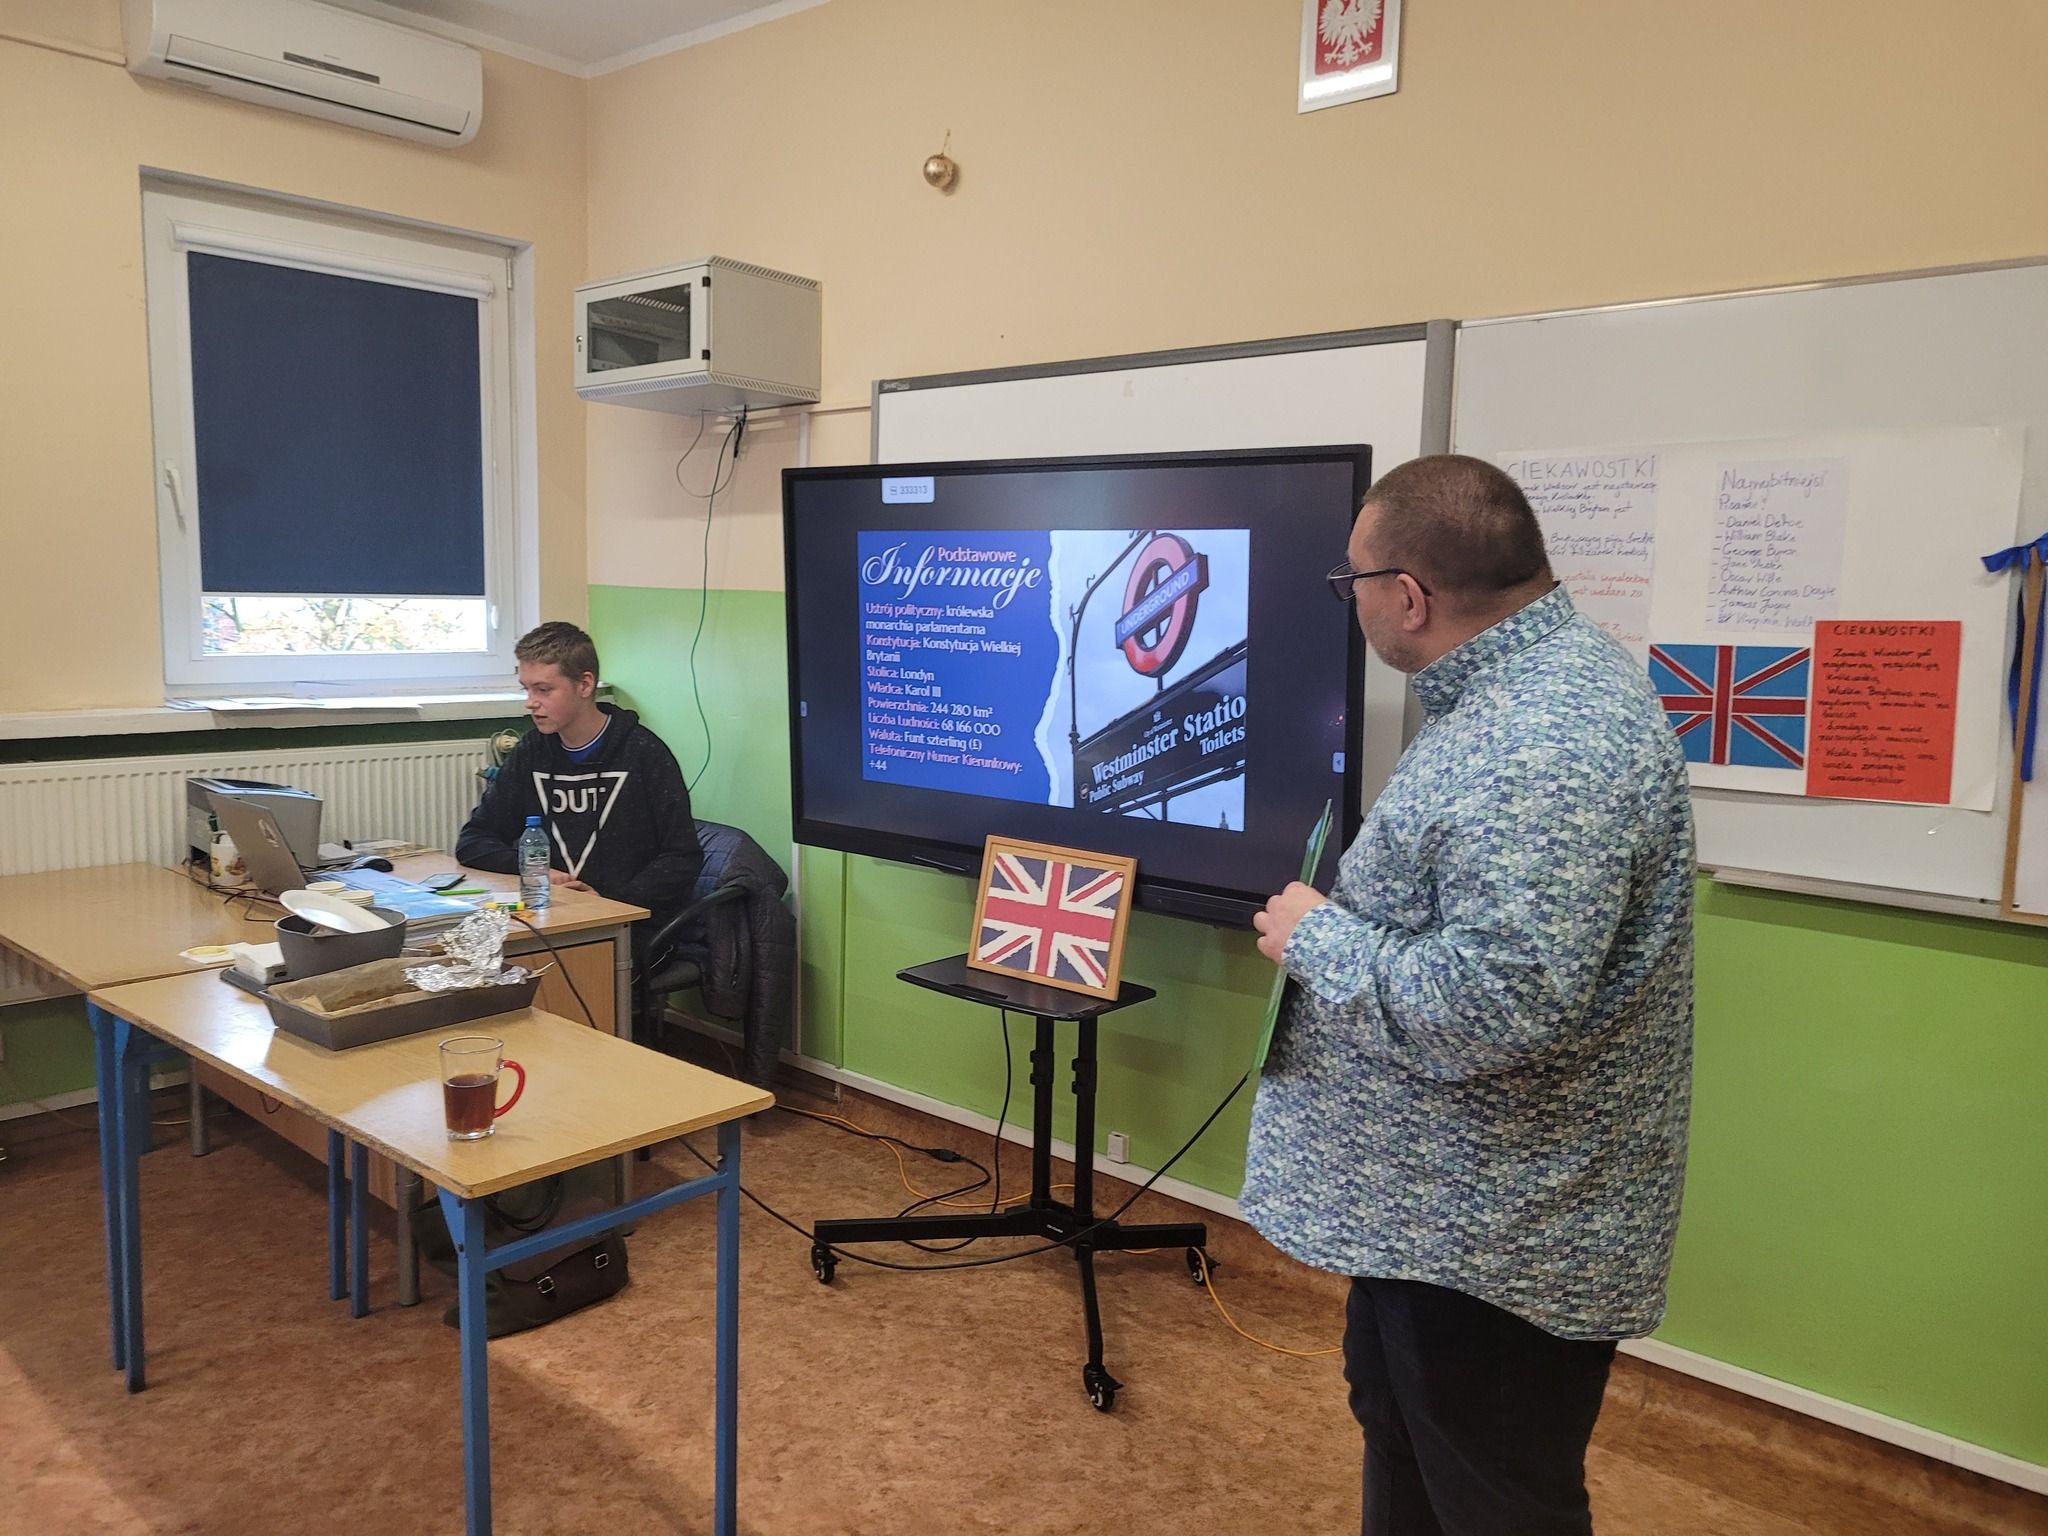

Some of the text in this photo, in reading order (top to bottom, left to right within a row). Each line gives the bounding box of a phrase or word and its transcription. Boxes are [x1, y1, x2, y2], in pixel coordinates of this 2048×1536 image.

[1505, 456, 1656, 481] CIEKAWOSTKI
[937, 546, 1017, 563] Podstawowe
[861, 542, 1043, 610] Informacje
[865, 602, 994, 620] Ustrój polityczny: królewska
[1121, 572, 1190, 634] UNDERGROUND
[865, 619, 914, 632] monarchia
[1833, 624, 1937, 636] CIEKAWOSTKI
[866, 634, 1021, 657] Konstytucja: Konstytucja Wielkiej
[867, 666, 935, 683] Stolica: Londyn
[905, 684, 930, 697] Karol
[932, 686, 942, 698] III
[868, 697, 993, 718] Powierzchnia: 244 280 km²
[868, 712, 896, 725] Liczba
[941, 718, 954, 731] 68
[955, 720, 972, 733] 166
[973, 722, 1001, 736] 000
[868, 728, 903, 742] Waluta:
[904, 731, 925, 744] Funt
[926, 734, 967, 751] szterling
[1092, 695, 1247, 785] Westminster Statio
[1200, 726, 1246, 756] Toilets
[868, 743, 1023, 774] Telefoniczny Numer Kierunkowy:
[868, 760, 887, 771] +44
[1089, 770, 1145, 803] Public Subway
